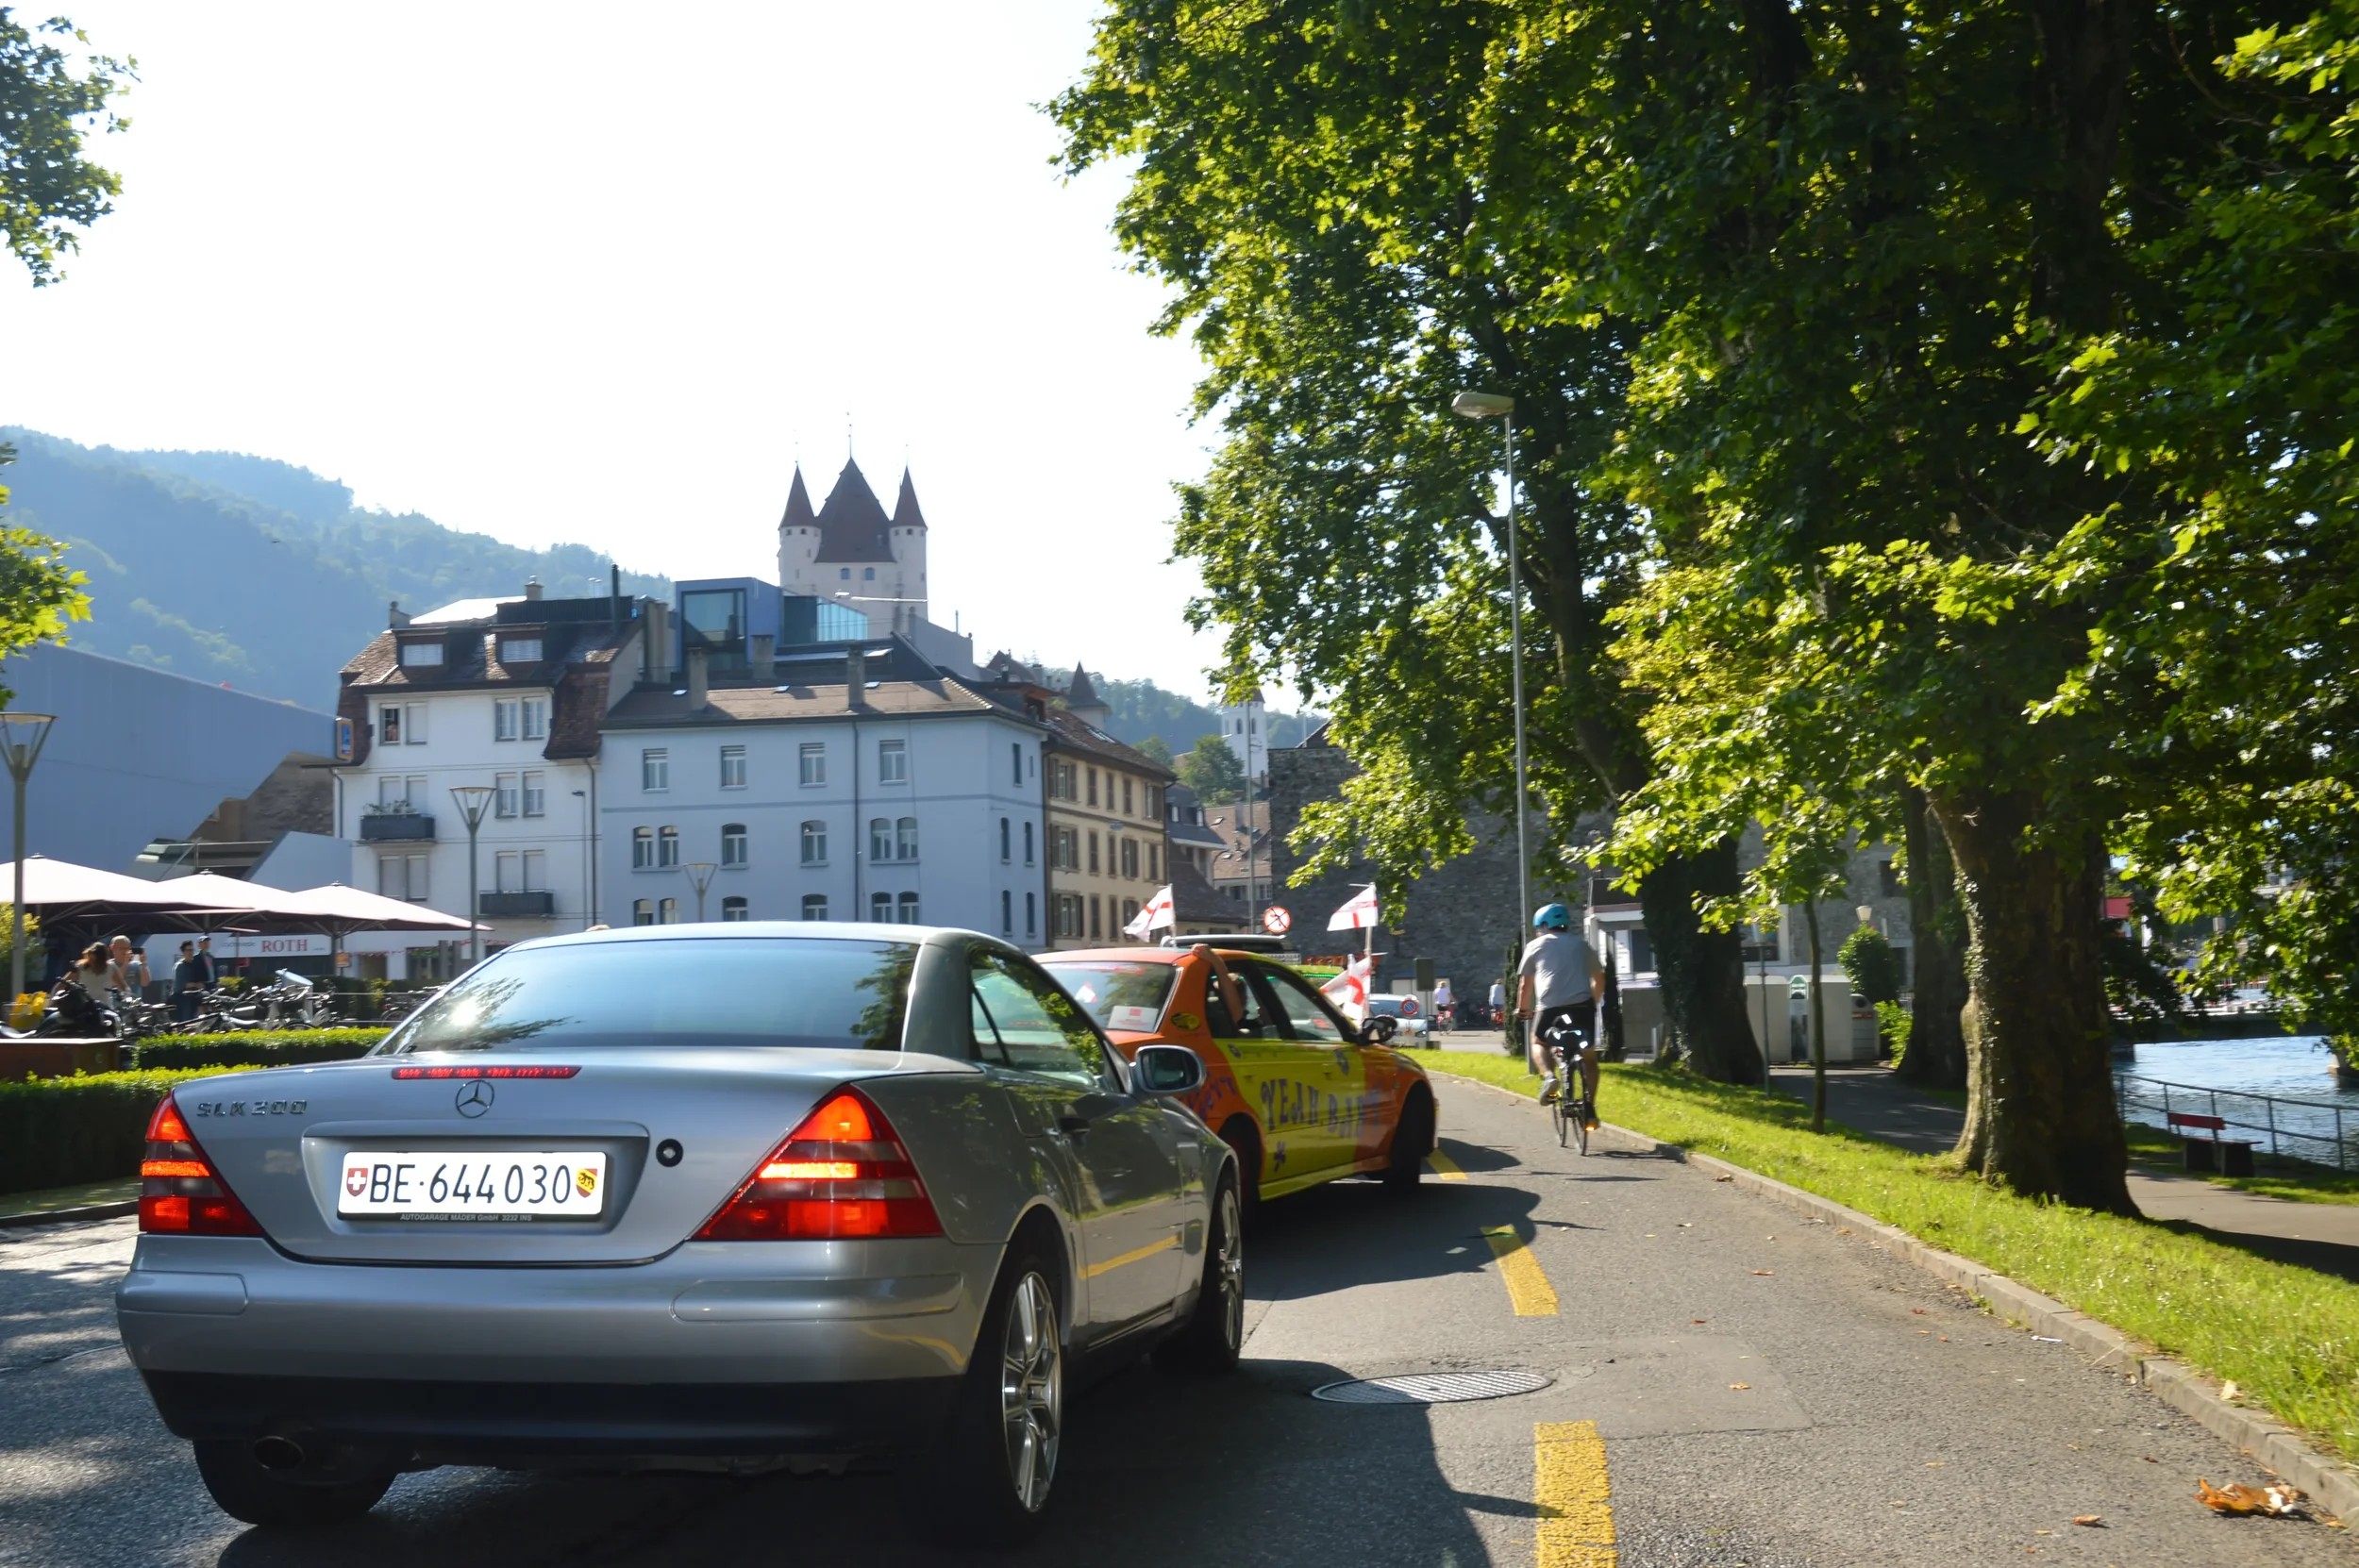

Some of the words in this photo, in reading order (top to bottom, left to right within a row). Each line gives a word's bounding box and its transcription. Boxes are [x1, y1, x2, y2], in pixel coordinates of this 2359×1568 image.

[260, 939, 309, 953] ROTH
[196, 1101, 245, 1117] SLK
[251, 1099, 308, 1115] 200
[1260, 1078, 1319, 1131] YEAH
